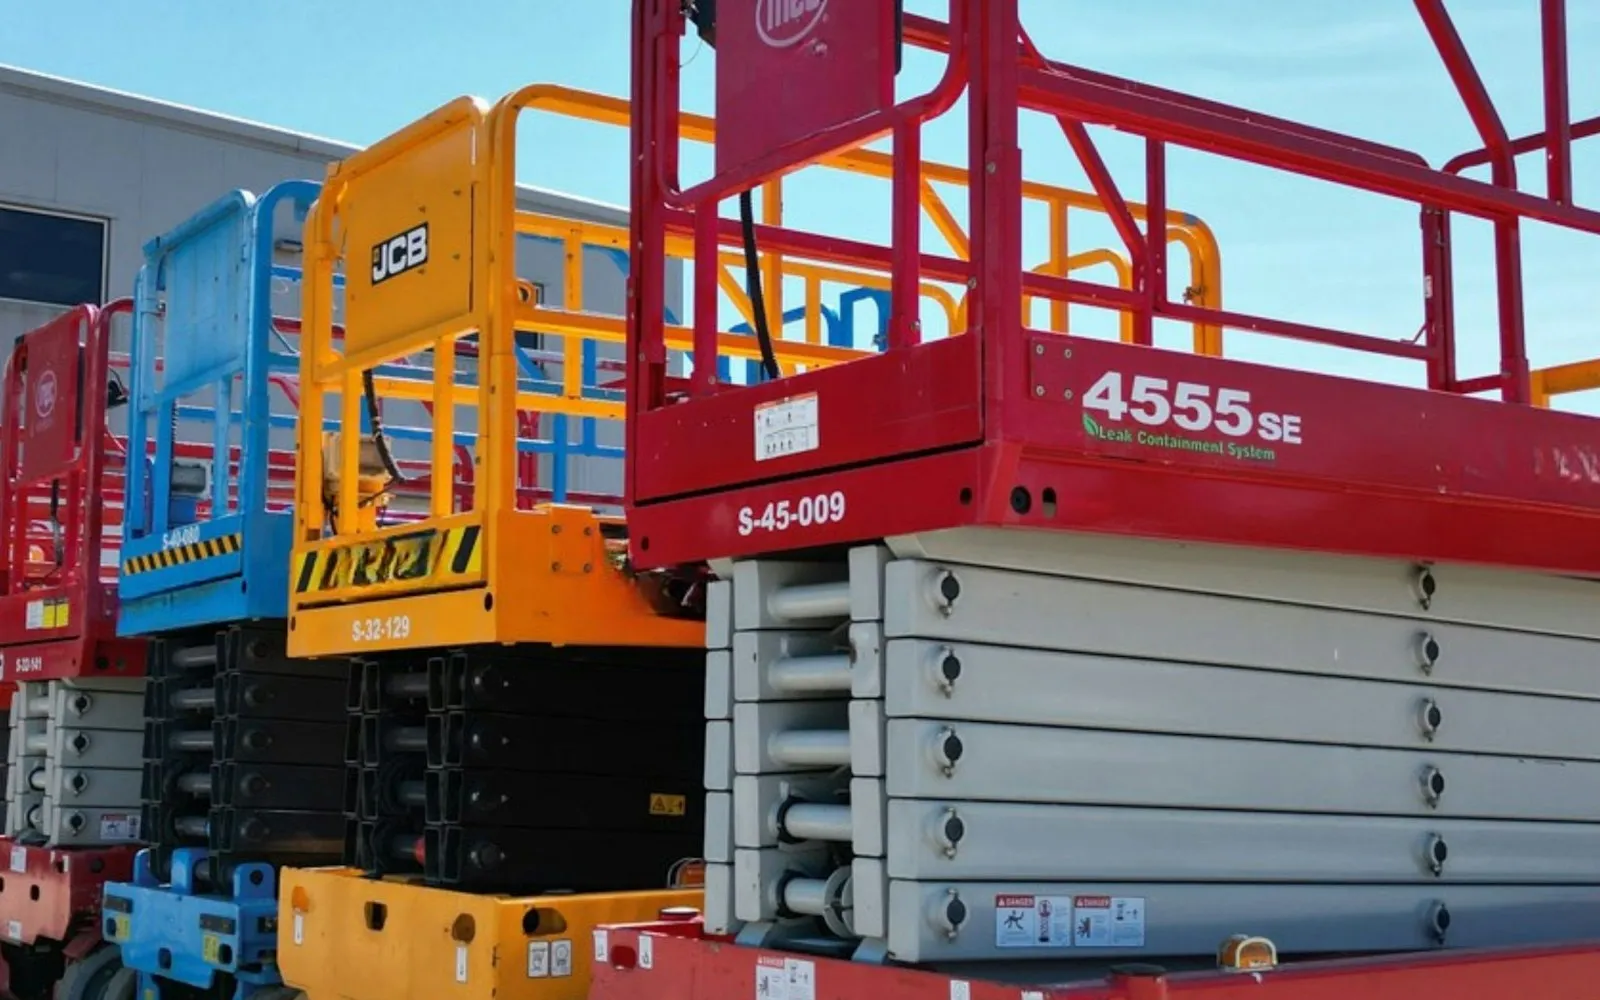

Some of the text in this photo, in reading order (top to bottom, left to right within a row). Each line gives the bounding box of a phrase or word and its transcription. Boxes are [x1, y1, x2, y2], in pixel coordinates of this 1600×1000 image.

[372, 226, 427, 281] JCB
[1082, 371, 1302, 444] 4555 SE
[1099, 426, 1275, 461] Leak Containment System
[738, 490, 845, 536] S-45-009
[352, 614, 410, 642] S-32-129
